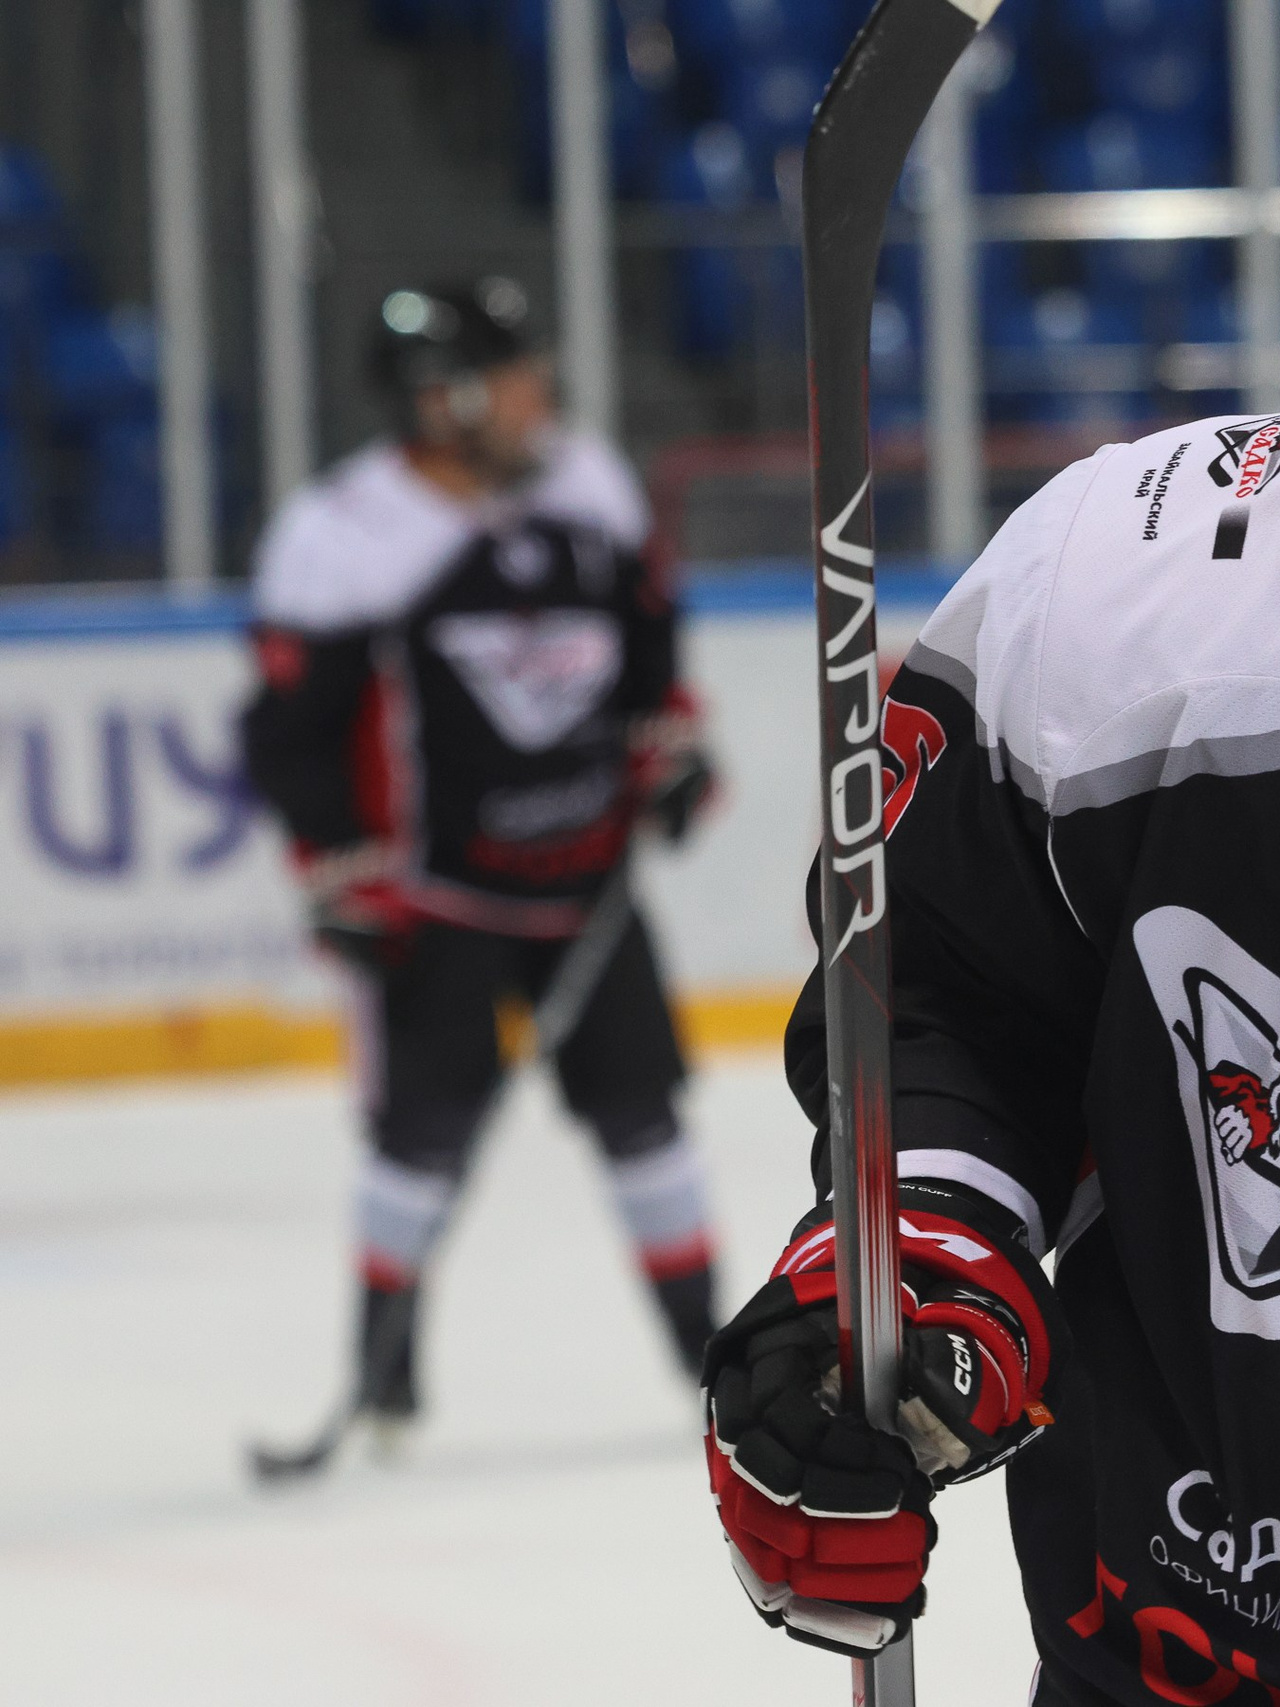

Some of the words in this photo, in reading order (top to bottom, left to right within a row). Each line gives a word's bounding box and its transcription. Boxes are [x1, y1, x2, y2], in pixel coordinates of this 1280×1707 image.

[1134, 468, 1157, 498] КРАЙ
[1235, 426, 1280, 499] САДКО
[821, 470, 886, 970] VAPOR
[947, 1333, 972, 1396] CCM
